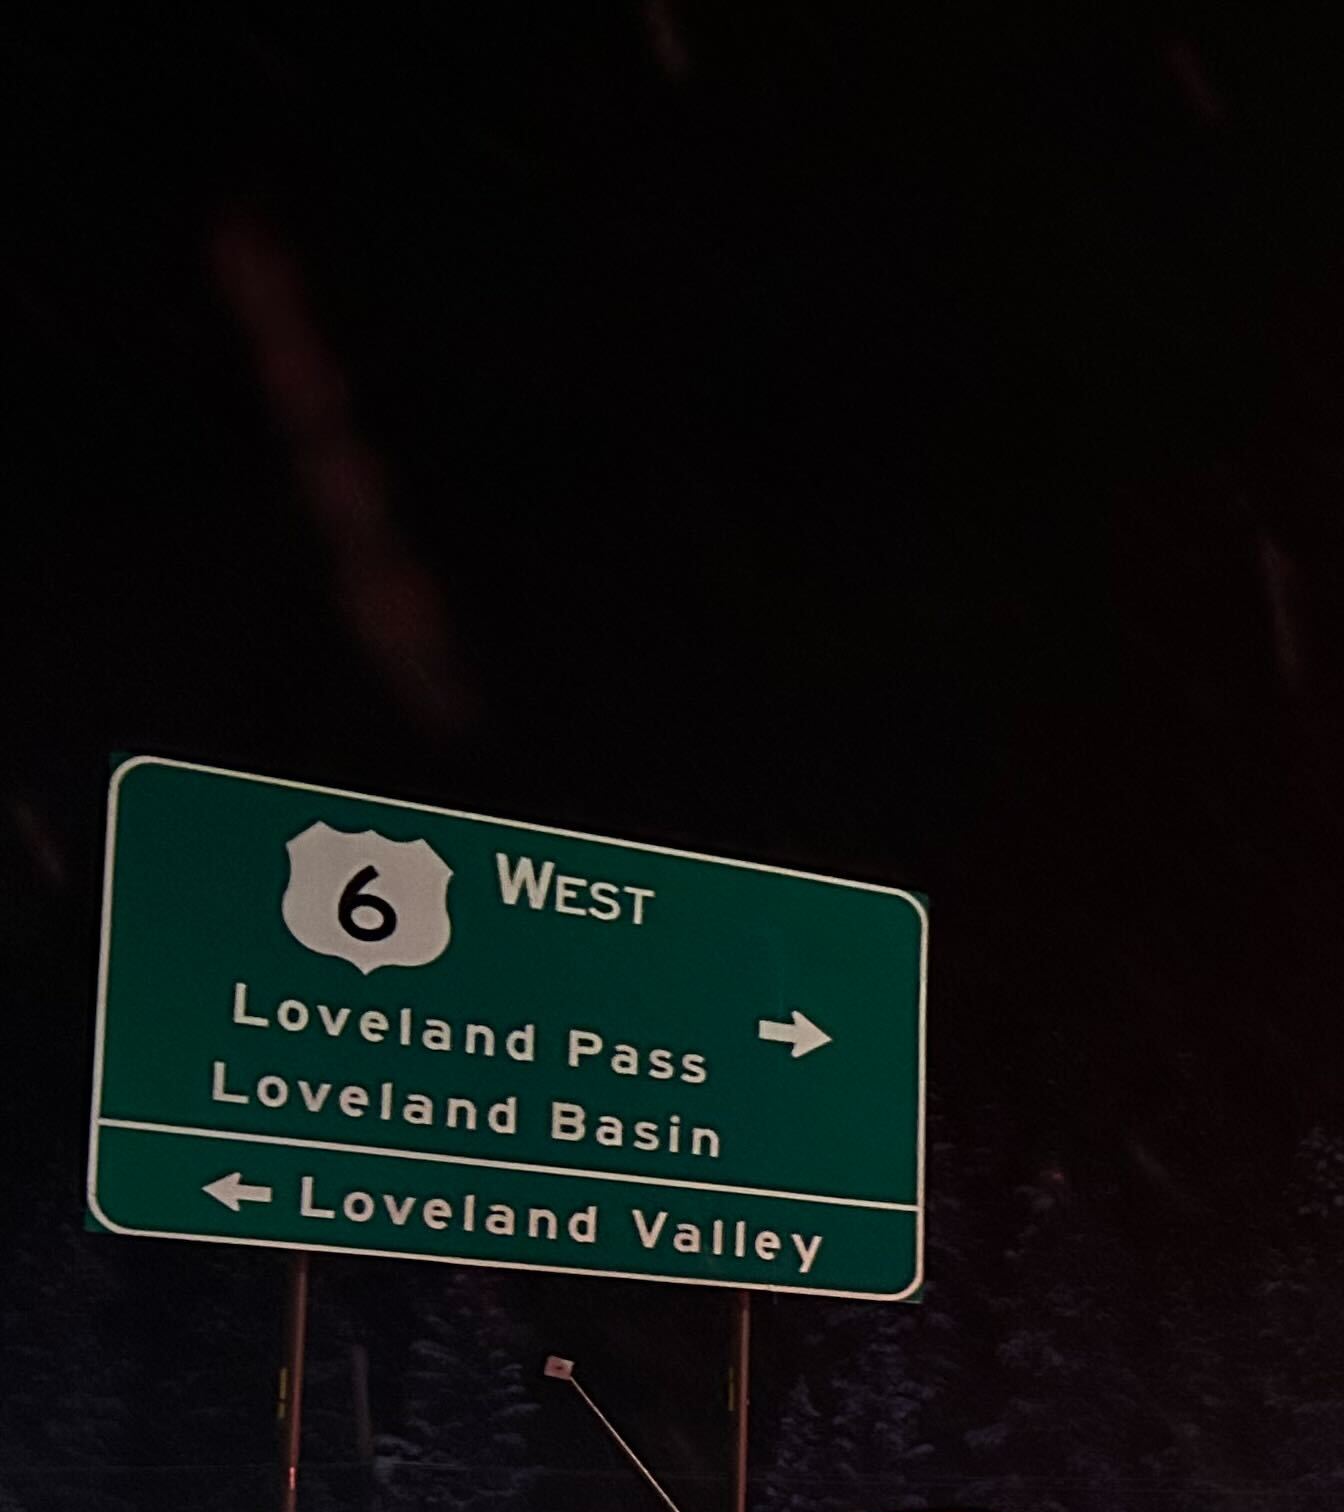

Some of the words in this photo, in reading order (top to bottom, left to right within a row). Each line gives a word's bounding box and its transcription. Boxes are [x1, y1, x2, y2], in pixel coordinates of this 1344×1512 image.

[338, 865, 397, 942] 6
[234, 982, 536, 1062] Loveland
[568, 1029, 707, 1084] Pass
[212, 1061, 518, 1134] Loveland
[551, 1101, 720, 1158] Basin
[300, 1176, 598, 1243] Loveland
[632, 1209, 823, 1273] Valley
